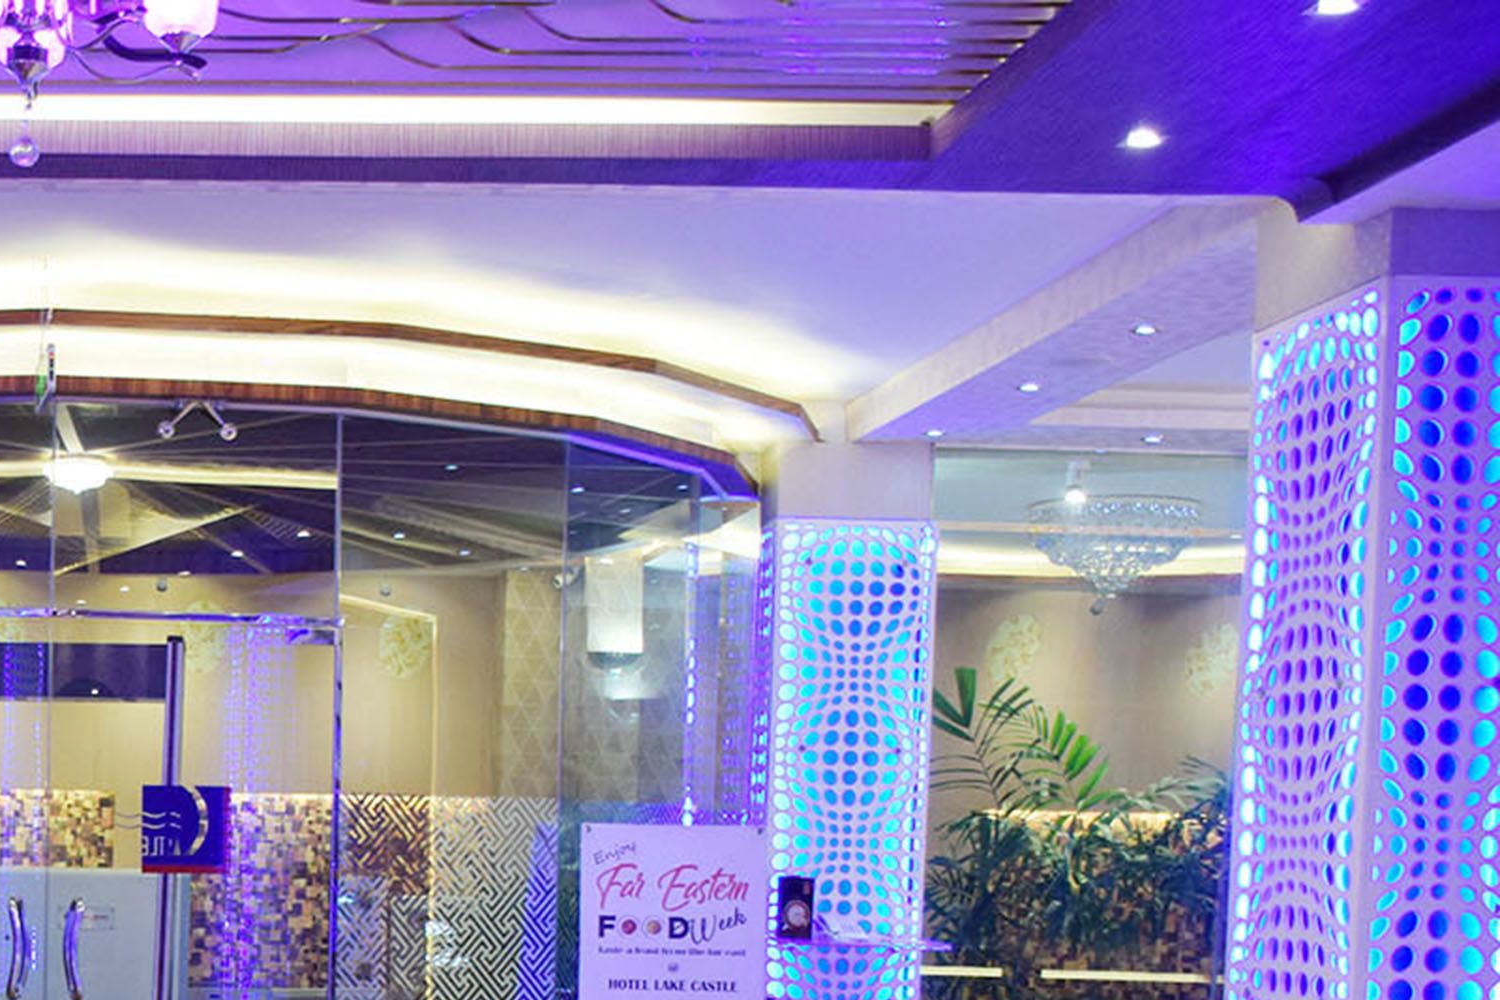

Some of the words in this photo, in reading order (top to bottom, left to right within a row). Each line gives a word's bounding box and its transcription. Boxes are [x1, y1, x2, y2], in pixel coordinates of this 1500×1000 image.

[593, 842, 636, 865] Enjoy
[596, 863, 645, 909] Far
[657, 864, 749, 912] Eastern
[608, 979, 649, 990] HOTEL
[654, 979, 686, 991] LAKE
[690, 980, 737, 992] CASTLE
